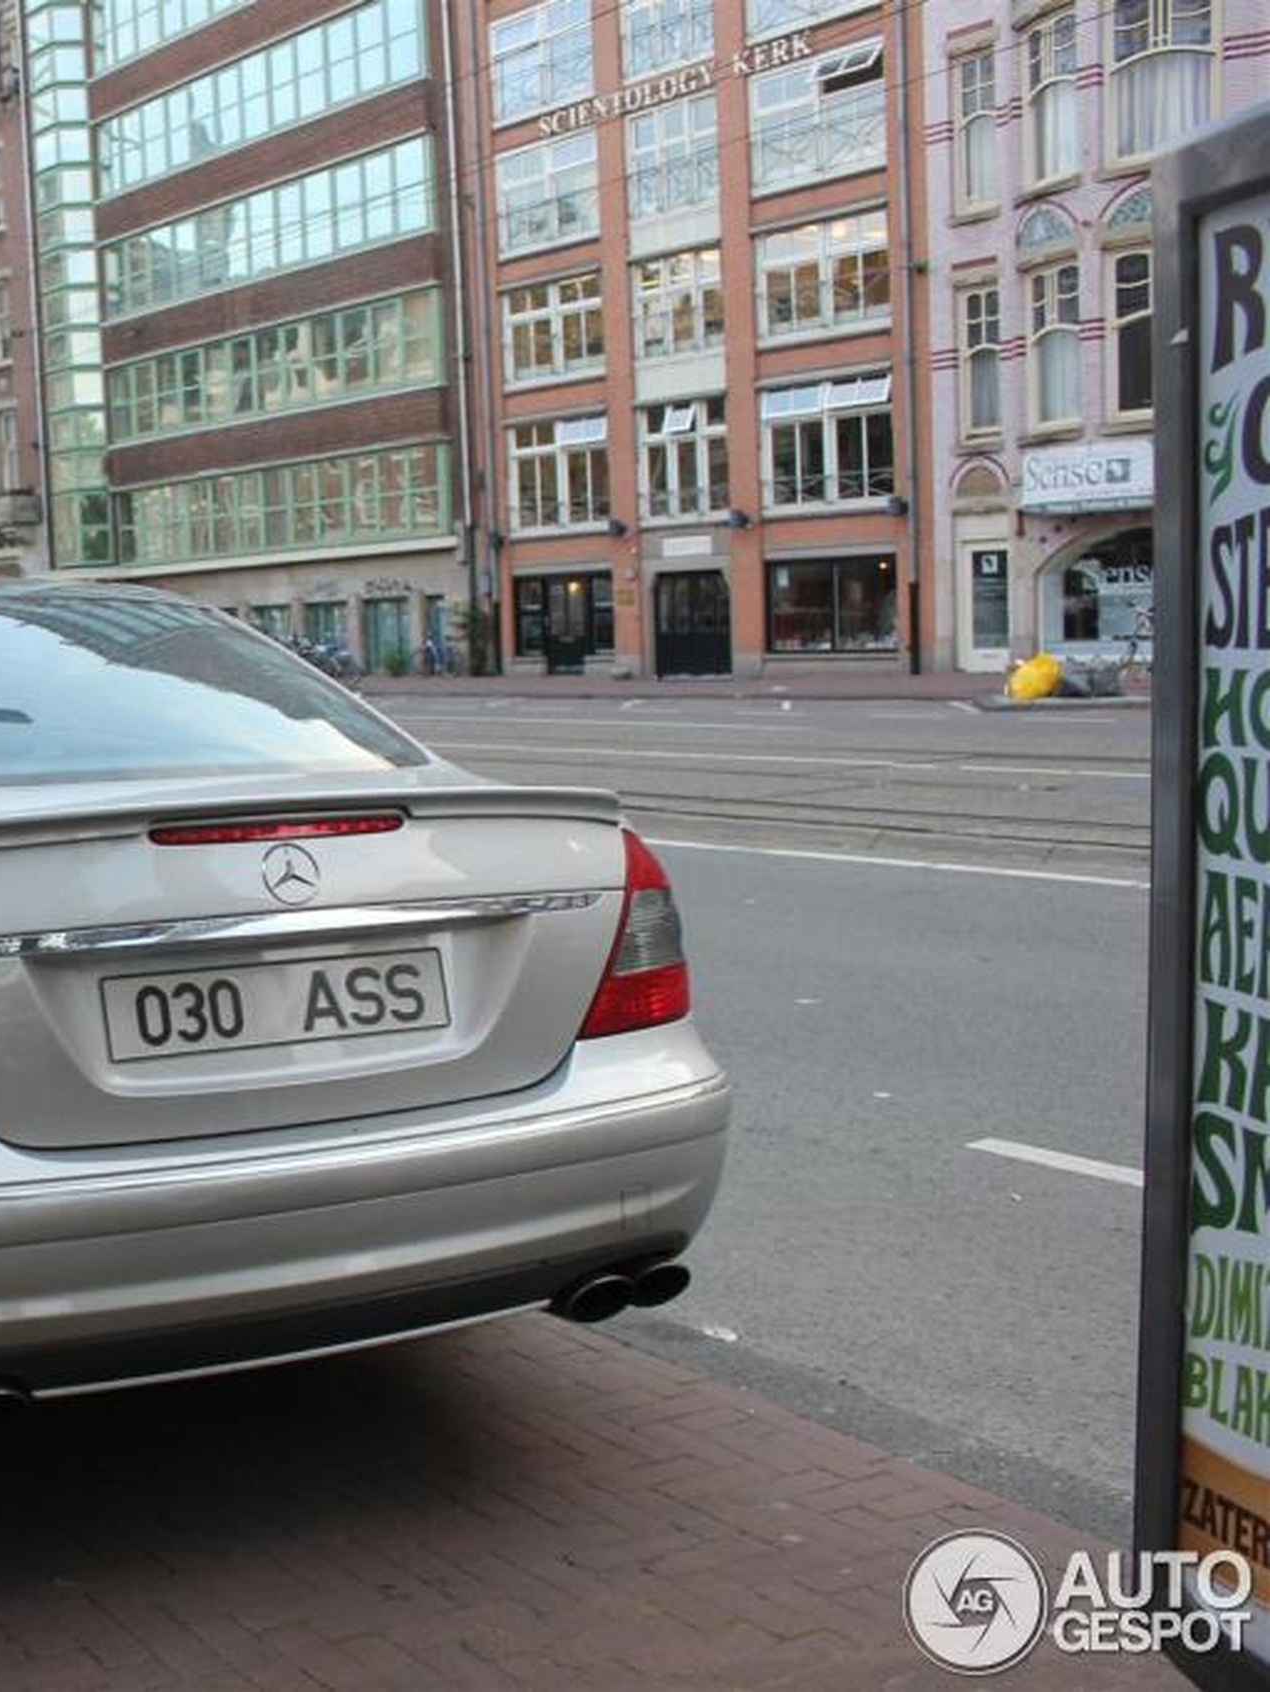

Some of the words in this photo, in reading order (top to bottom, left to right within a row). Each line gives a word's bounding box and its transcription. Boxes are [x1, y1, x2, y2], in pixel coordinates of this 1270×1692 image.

[537, 60, 716, 137] SCIENTOLOGY
[731, 31, 813, 76] KERK
[1210, 223, 1270, 375] R
[1027, 455, 1103, 492] Sense
[135, 978, 245, 1047] 030
[303, 963, 425, 1032] ASS
[1191, 1253, 1270, 1351] DIMI
